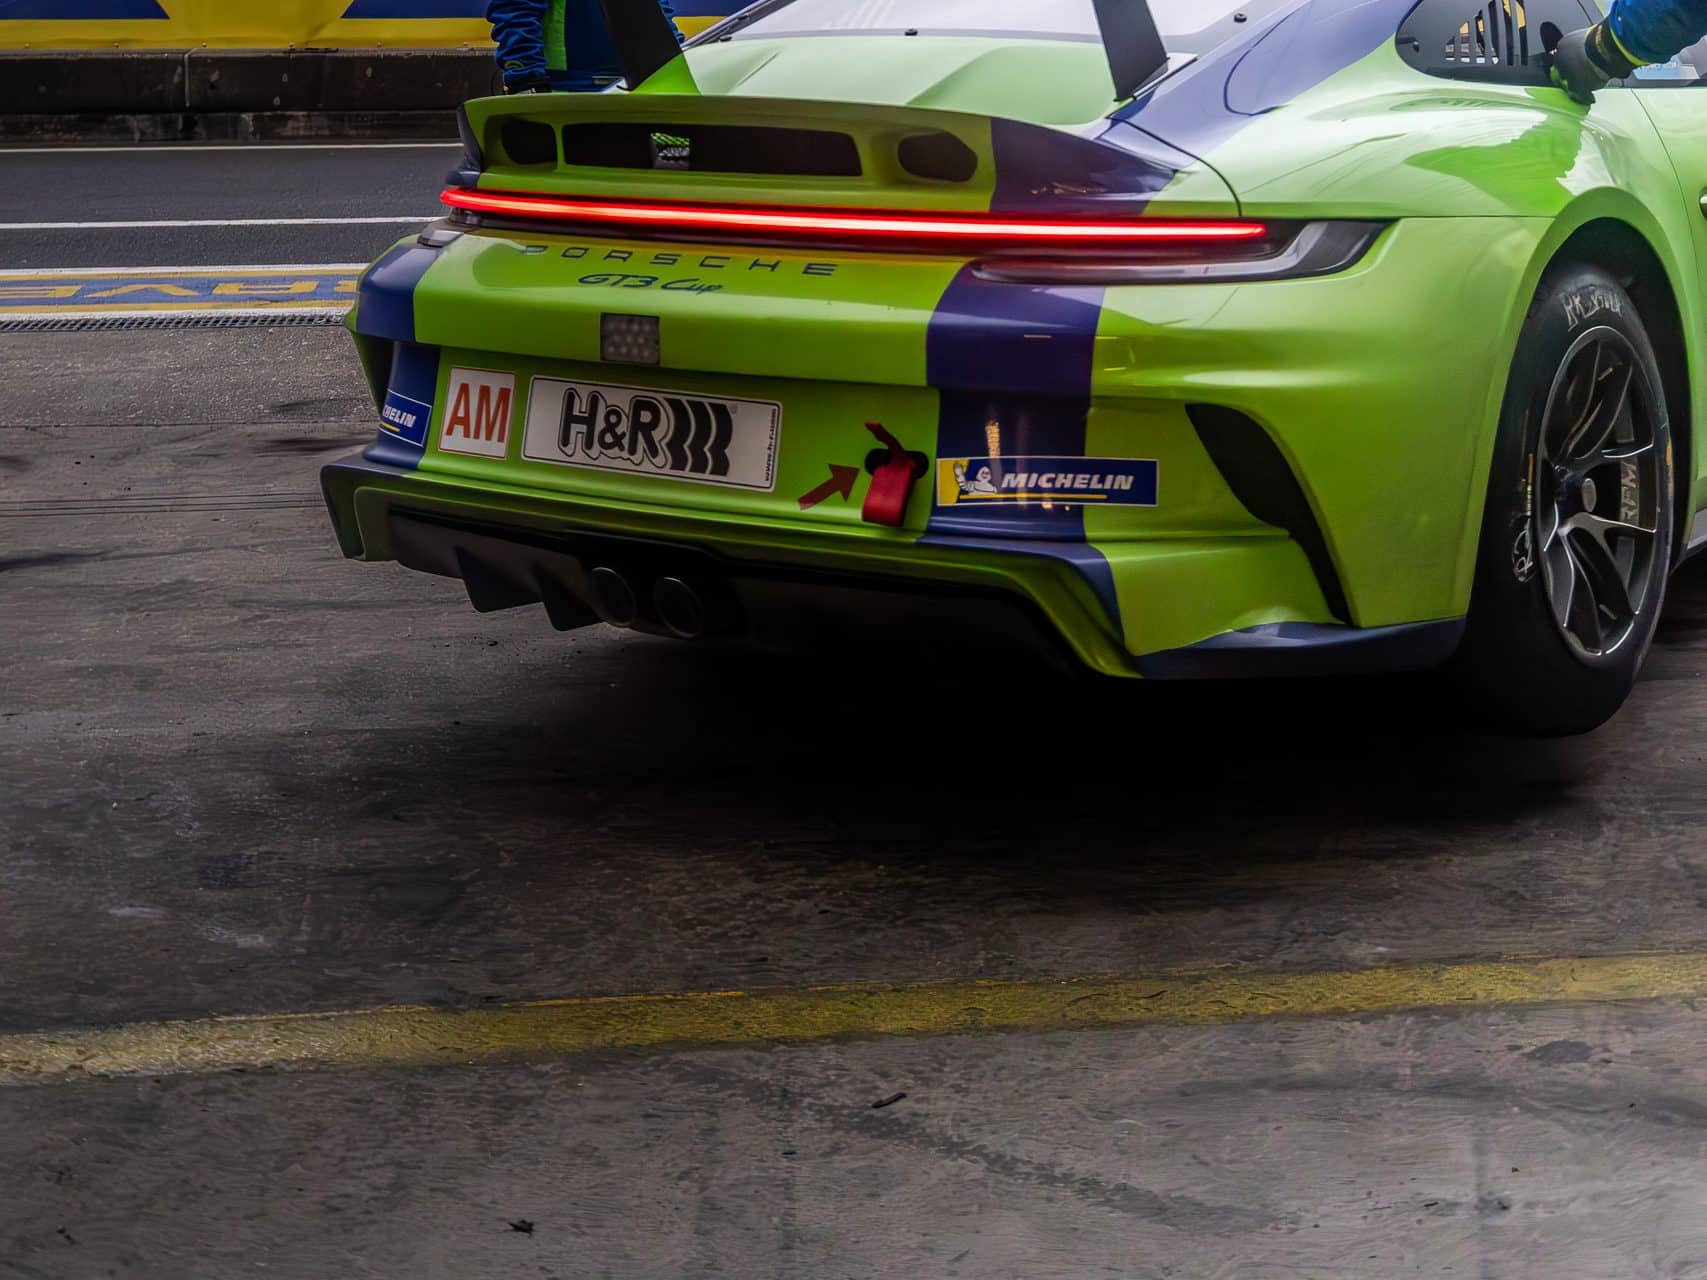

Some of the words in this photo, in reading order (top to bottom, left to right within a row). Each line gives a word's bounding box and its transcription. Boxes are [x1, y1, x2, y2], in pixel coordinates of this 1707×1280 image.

[520, 244, 838, 277] PORSCHE
[578, 273, 659, 289] GT3
[660, 277, 724, 295] Cup
[446, 382, 512, 443] AM
[559, 388, 668, 467] H&R
[1001, 472, 1135, 491] MICHELIN
